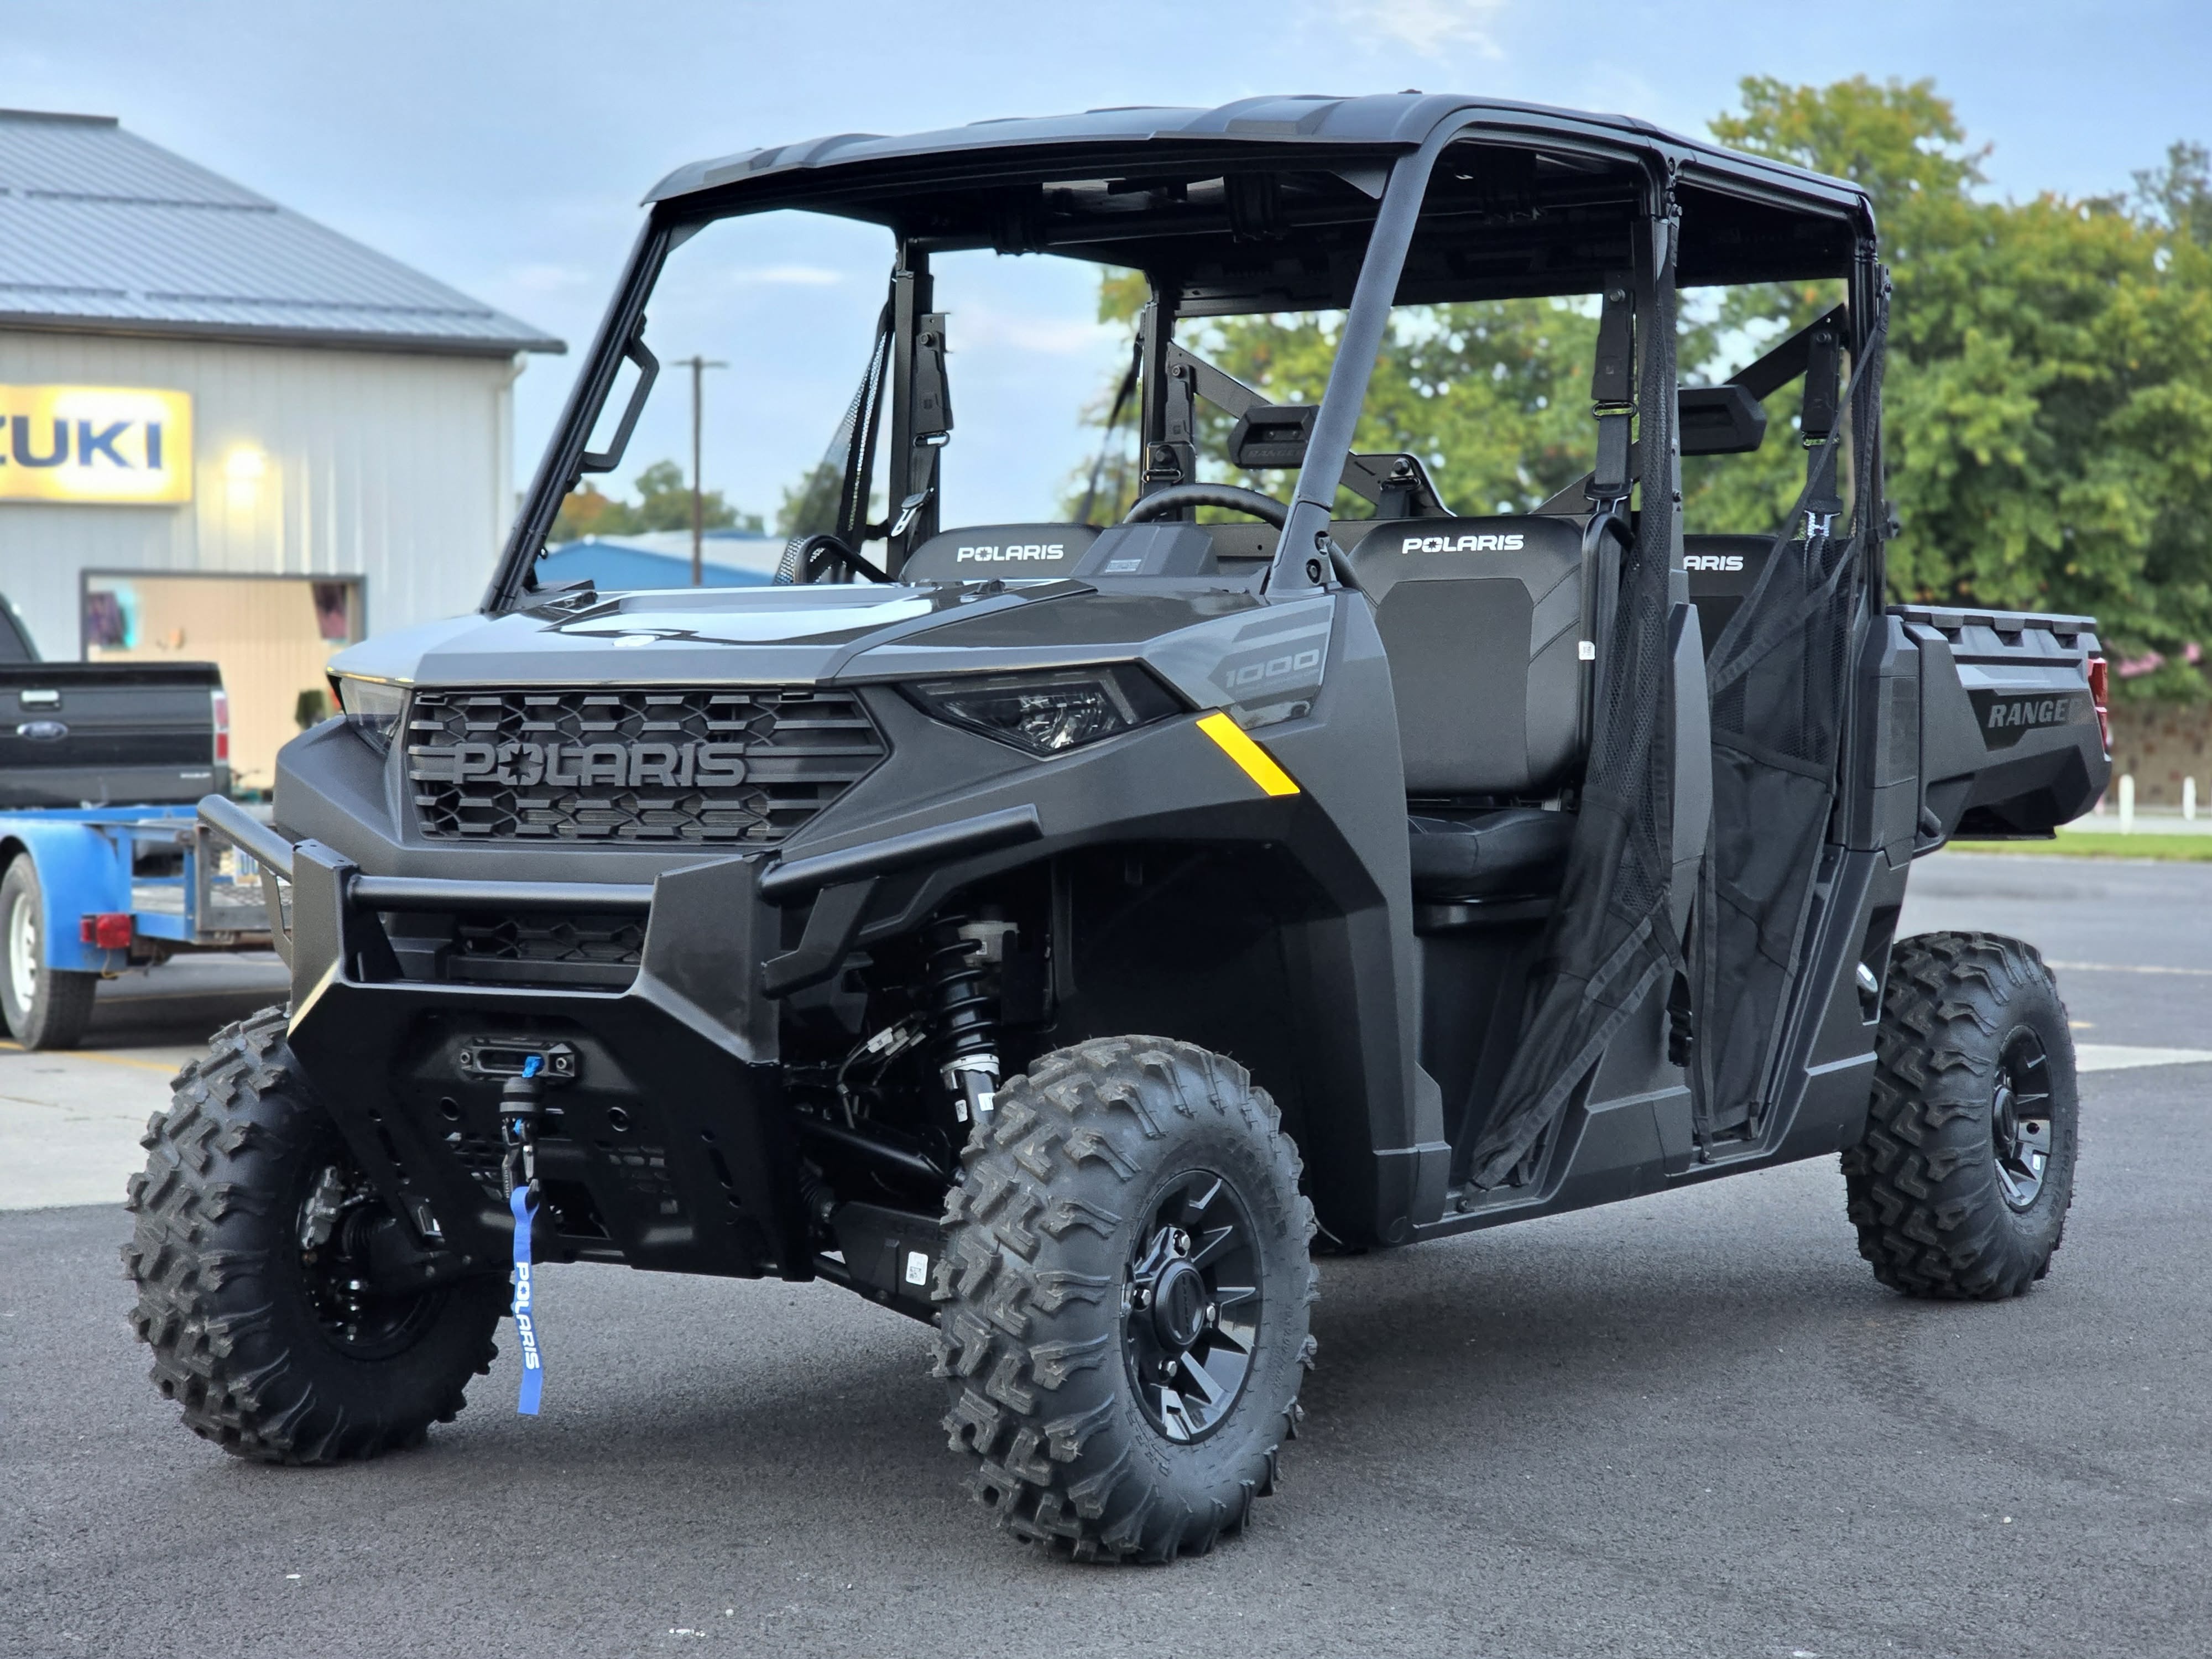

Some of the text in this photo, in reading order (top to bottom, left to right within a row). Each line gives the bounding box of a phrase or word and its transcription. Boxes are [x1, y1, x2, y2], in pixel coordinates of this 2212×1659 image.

[0, 414, 163, 469] UKI
[957, 544, 1064, 562] POLARIS
[1402, 535, 1524, 554] POLARIS
[1683, 555, 1744, 571] ARIS
[1225, 649, 1320, 688] 1000
[452, 743, 746, 786] POLARIS
[514, 1262, 540, 1370] POLARIS
